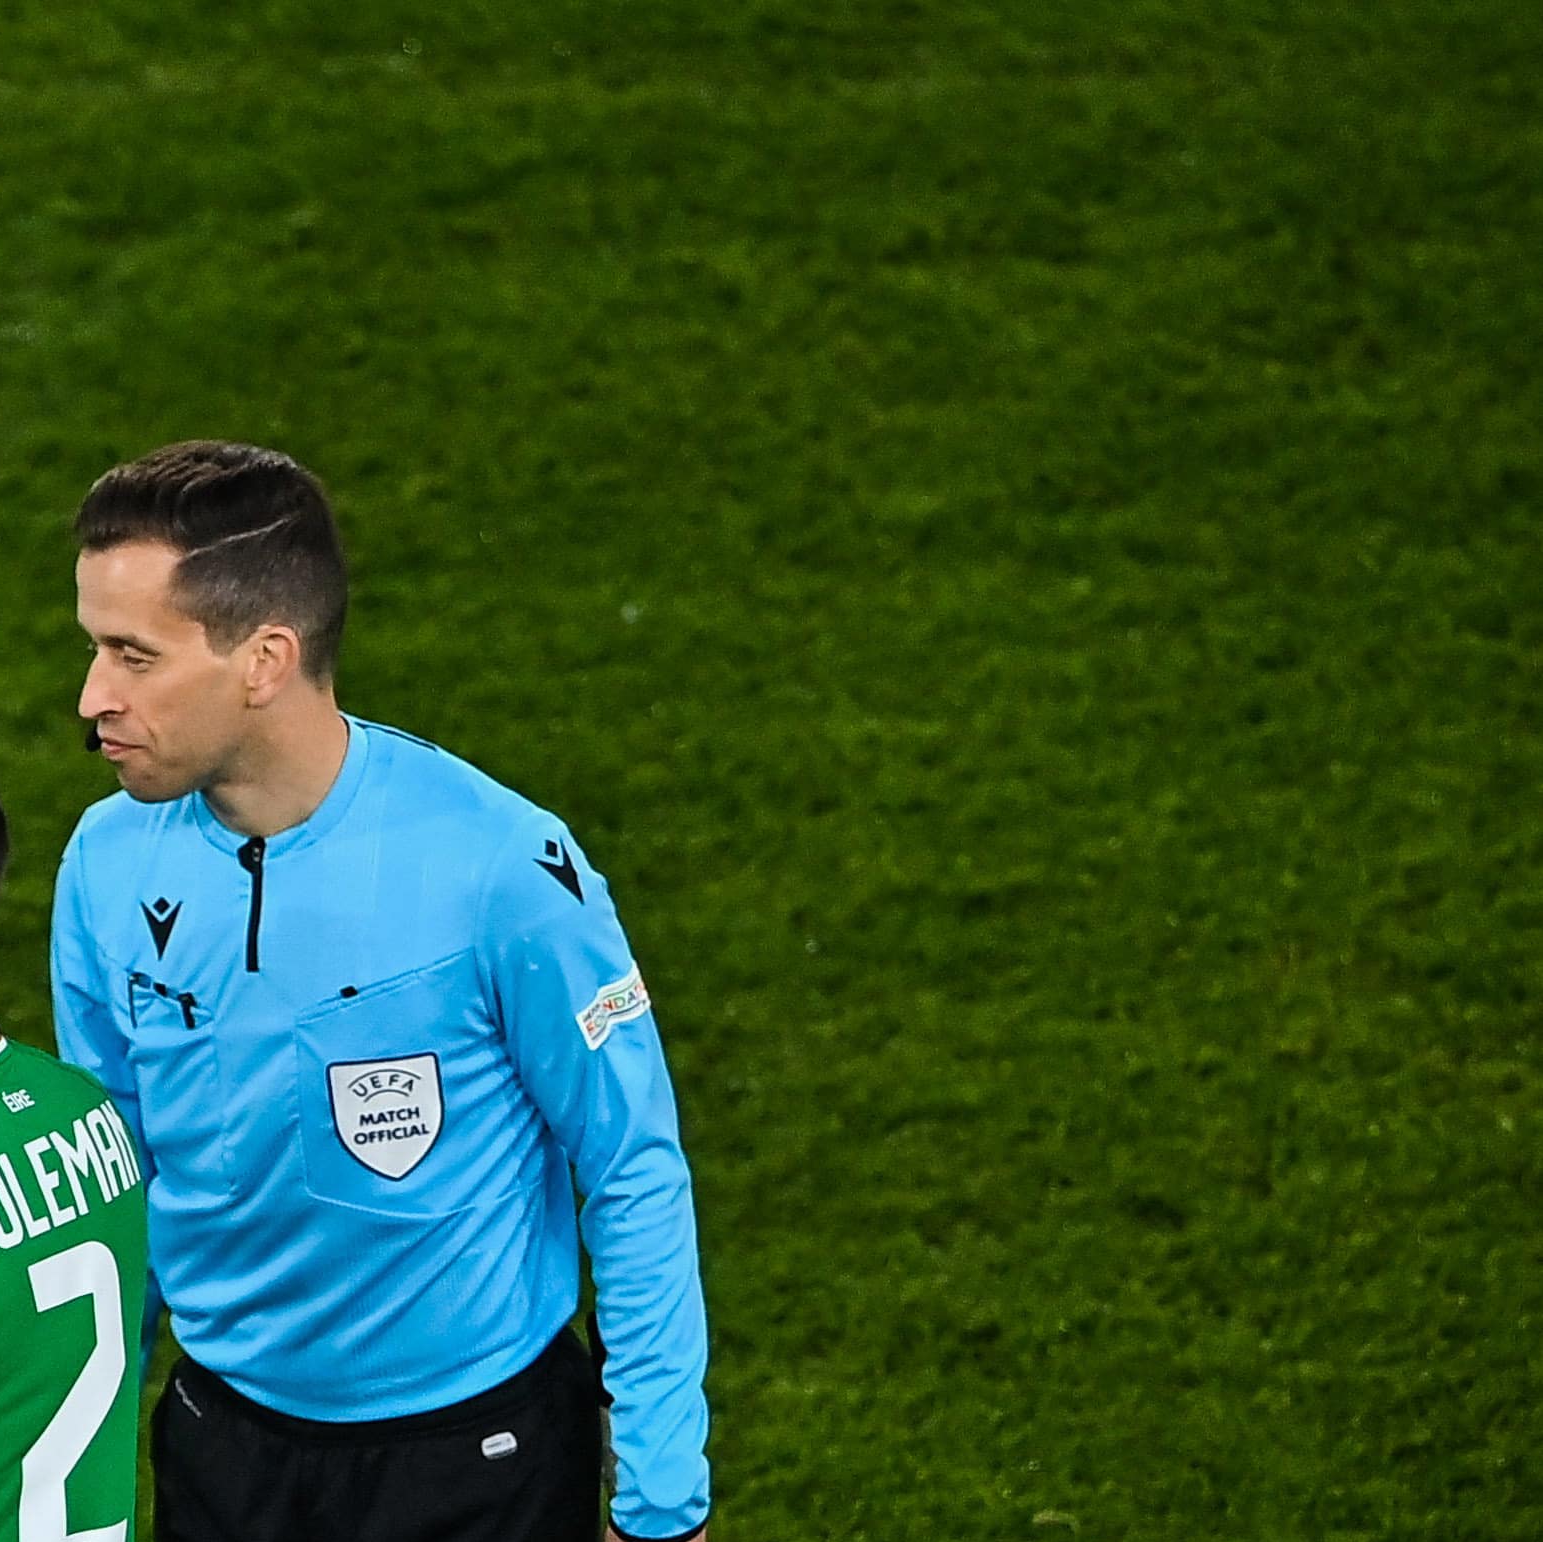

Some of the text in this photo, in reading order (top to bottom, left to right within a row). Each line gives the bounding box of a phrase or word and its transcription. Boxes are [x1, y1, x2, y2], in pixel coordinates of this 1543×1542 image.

[352, 1073, 414, 1098] UEFA
[359, 1106, 420, 1127] MATCH
[353, 1123, 430, 1145] OFFICIAL
